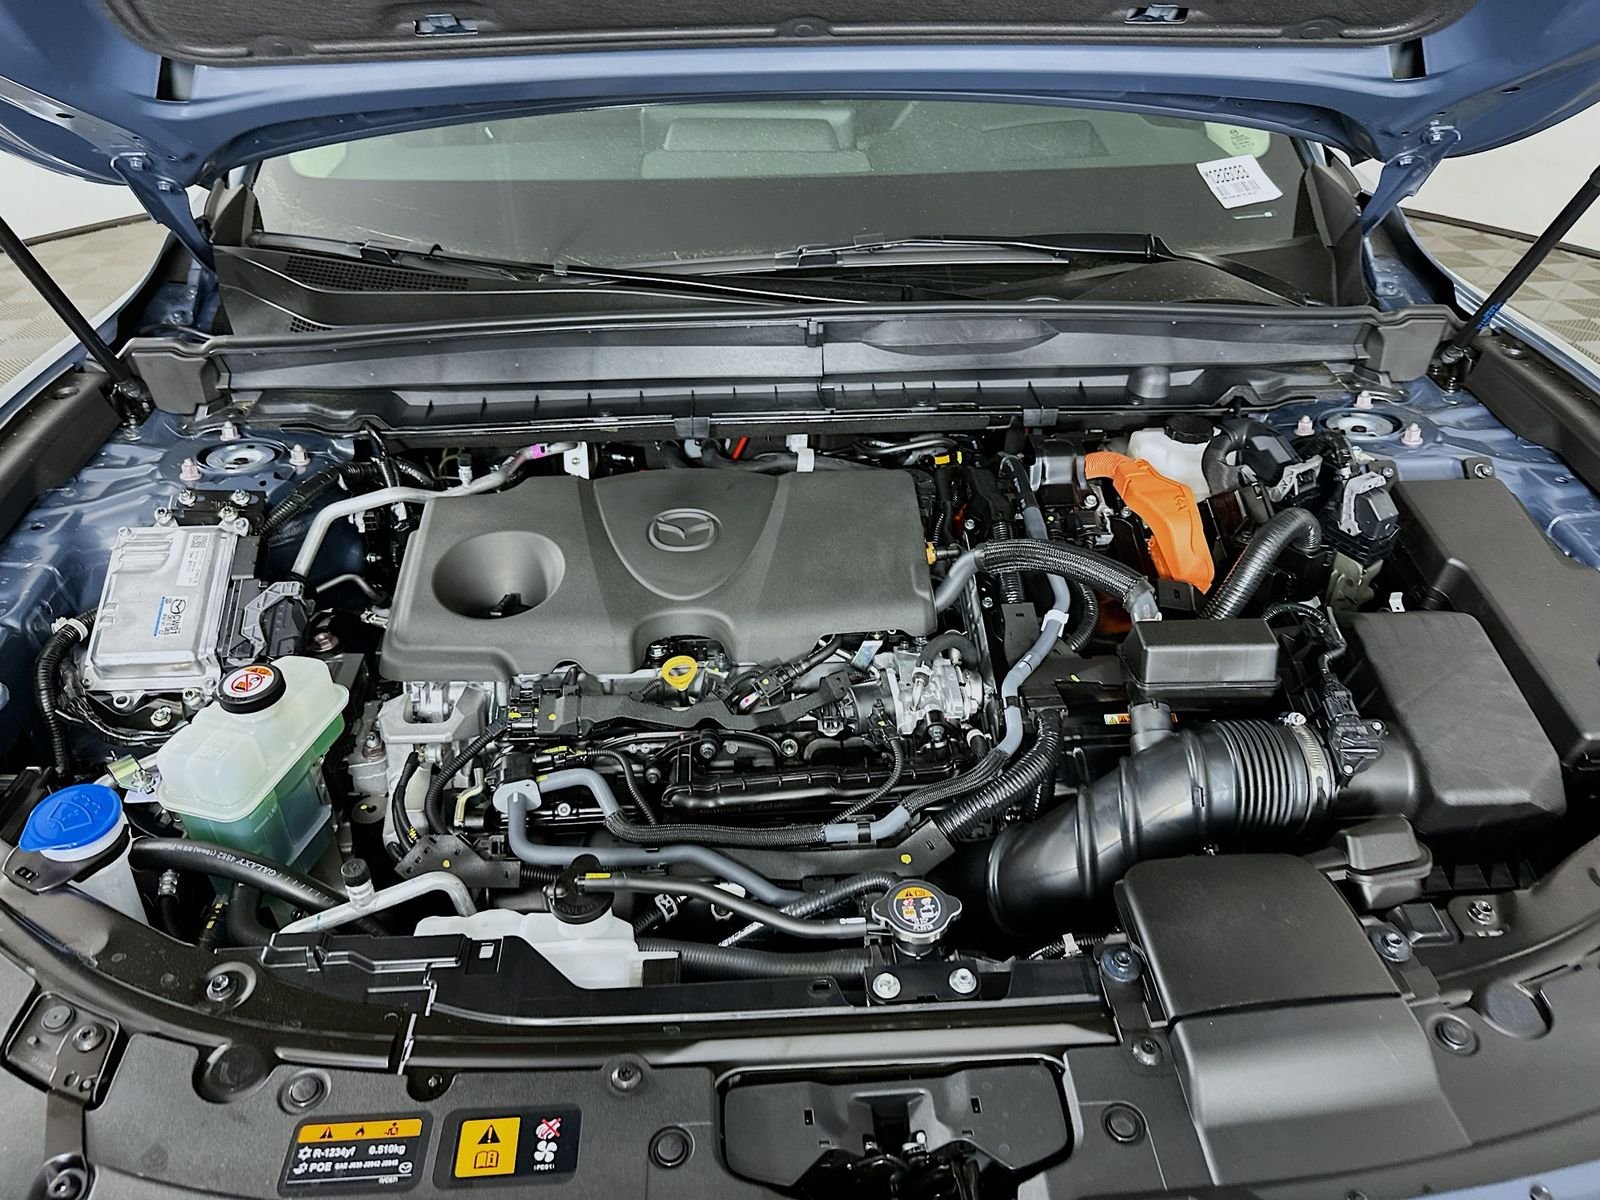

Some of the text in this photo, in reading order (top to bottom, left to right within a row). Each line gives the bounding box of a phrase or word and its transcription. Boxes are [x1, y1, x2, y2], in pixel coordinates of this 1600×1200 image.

[237, 857, 277, 877] GALAXY
[312, 1145, 357, 1160] R-1234yf
[308, 1161, 333, 1174] POE
